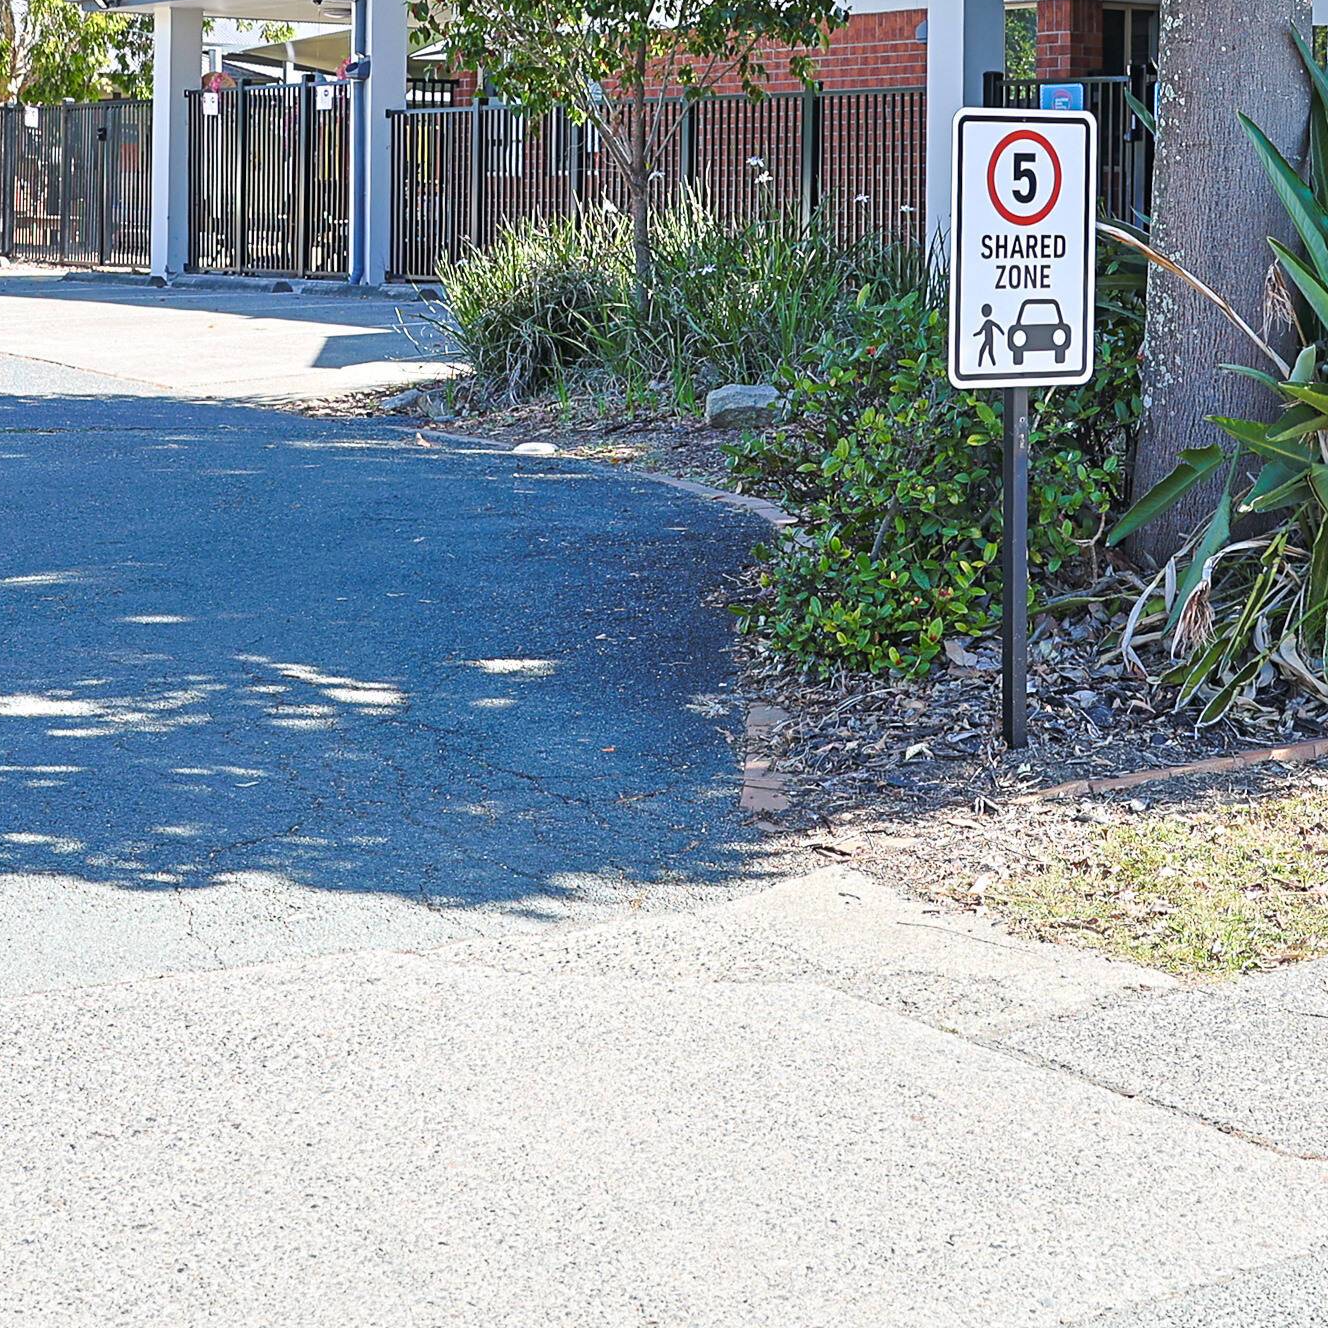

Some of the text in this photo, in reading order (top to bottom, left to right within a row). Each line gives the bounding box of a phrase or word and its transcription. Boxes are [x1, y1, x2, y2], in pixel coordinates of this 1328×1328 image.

[1012, 153, 1037, 204] 5
[981, 234, 1066, 260] SHARED
[995, 265, 1051, 290] ZONE
